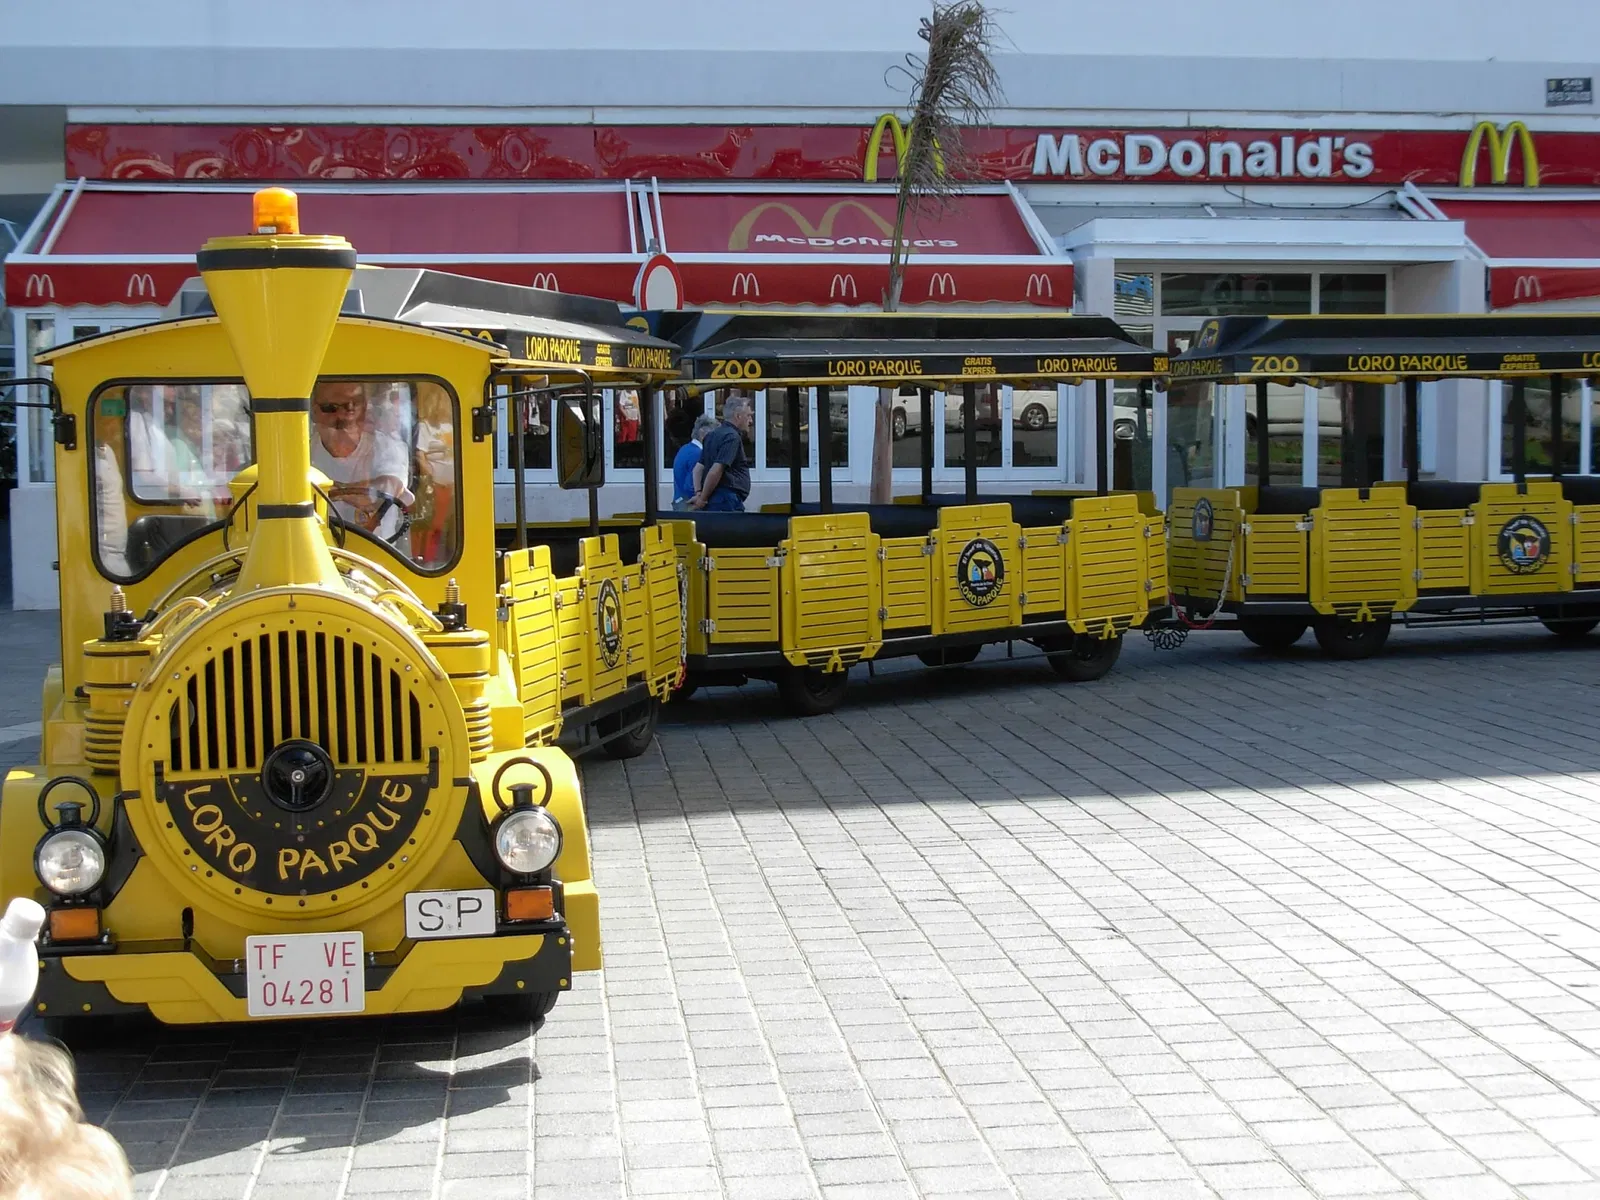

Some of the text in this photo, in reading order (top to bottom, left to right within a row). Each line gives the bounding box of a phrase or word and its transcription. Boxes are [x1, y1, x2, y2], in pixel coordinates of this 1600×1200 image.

[1032, 133, 1375, 179] McDonald's
[754, 233, 959, 248] McDonald's
[525, 335, 549, 361] LORO
[549, 337, 581, 364] PARQUE
[1503, 353, 1536, 362] GRATIS
[627, 347, 672, 370] LORO PARQUE
[964, 357, 993, 366] GRATIS
[1036, 357, 1118, 373] LORO PARQUE
[1191, 358, 1223, 375] PARQUE
[1251, 355, 1299, 373] ZOO
[1348, 355, 1468, 371] LORO PARQUE
[1500, 362, 1540, 370] EXPRESS
[710, 359, 762, 379] ZOO
[828, 360, 923, 377] LORO PARQUE
[961, 366, 997, 375] EXPRESS
[184, 779, 412, 881] LORO PARQUE
[418, 896, 482, 931] SP
[254, 941, 356, 970] TF VE
[262, 978, 350, 1007] 04281
